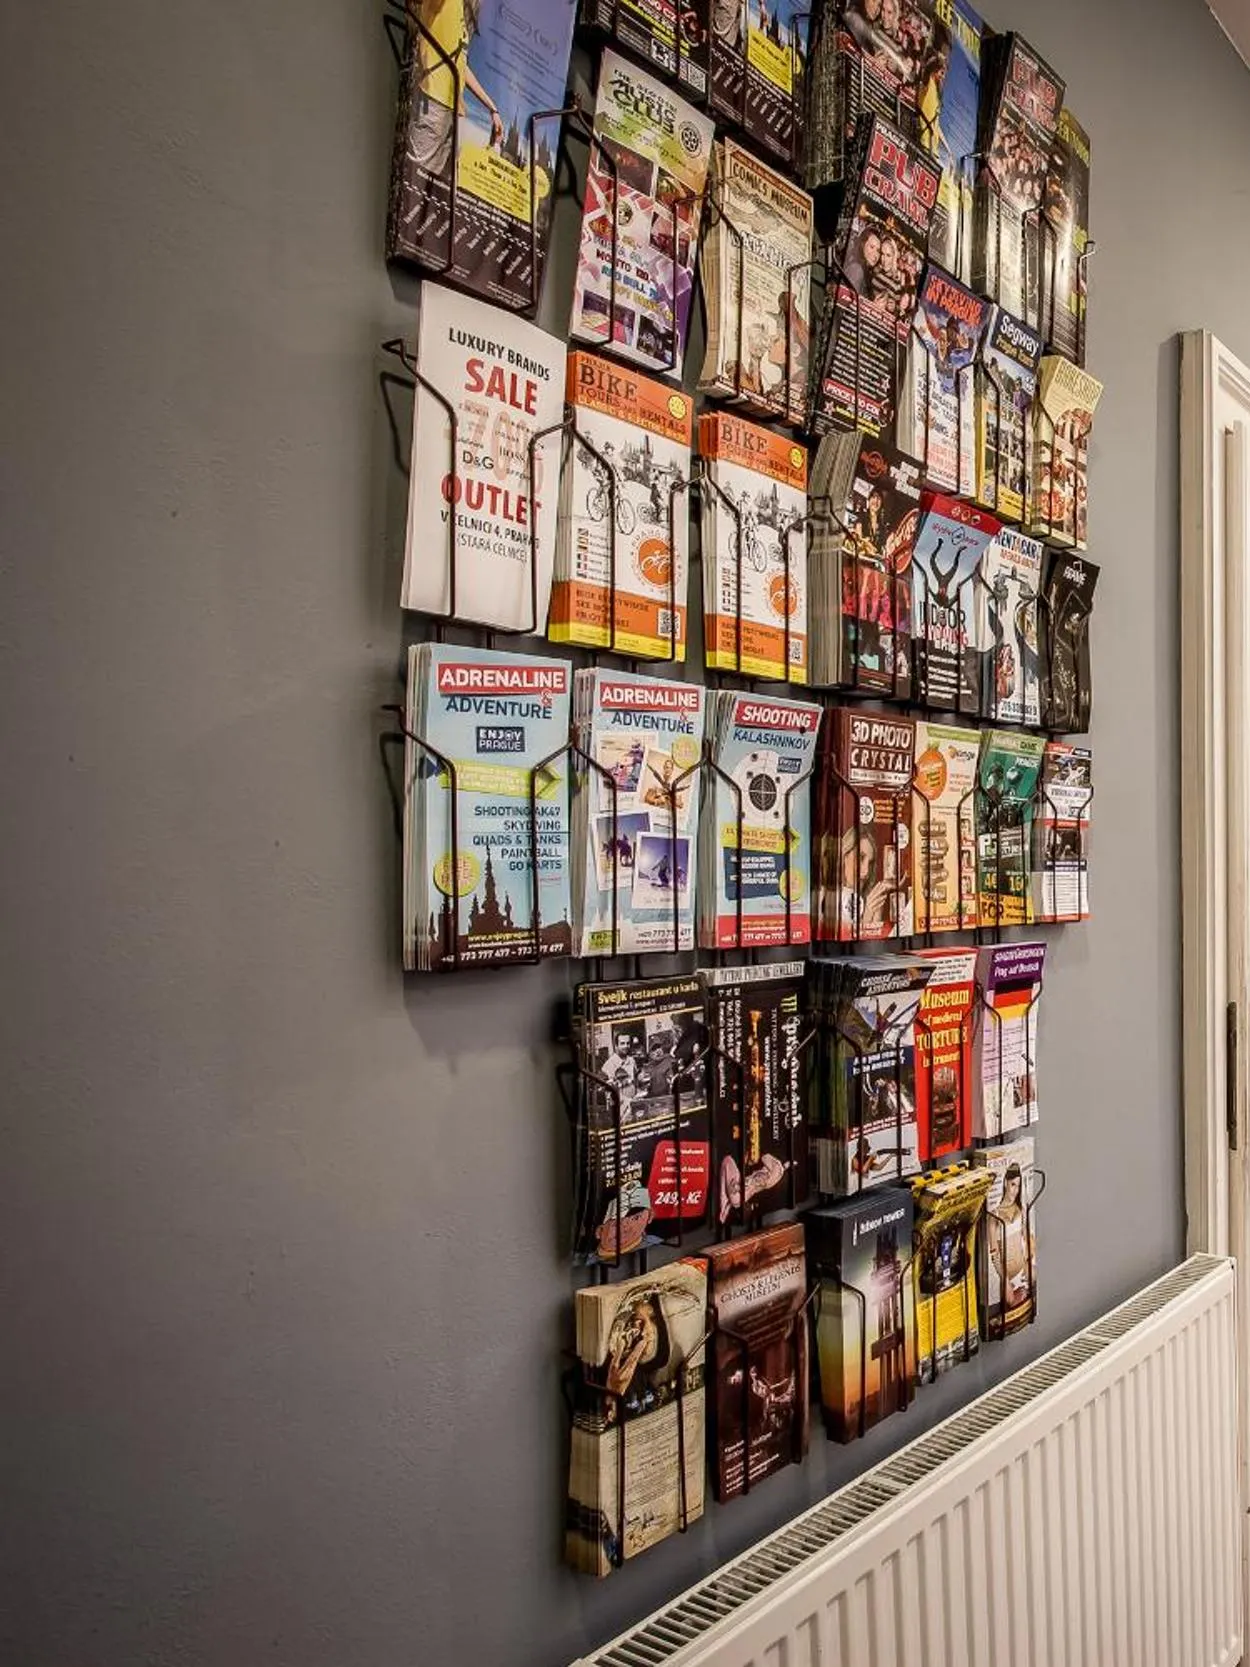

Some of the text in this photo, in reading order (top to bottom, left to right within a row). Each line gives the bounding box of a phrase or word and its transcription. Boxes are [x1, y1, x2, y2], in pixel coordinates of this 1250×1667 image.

[609, 79, 677, 123] MUSIC
[613, 90, 674, 140] CLUB
[869, 131, 938, 209] PUB
[732, 161, 808, 224] COMICS MUSEUM
[864, 166, 929, 232] CRAWL
[1000, 315, 1039, 357] Segway
[448, 328, 550, 381] LUXURY BRANDS
[465, 357, 537, 416] SALE
[580, 364, 638, 402] BIKE
[579, 386, 620, 408] TOURS
[640, 407, 686, 434] RENTALS
[722, 424, 767, 455] BIKE
[462, 449, 495, 470] D&G
[442, 473, 542, 525] OUTLET
[453, 513, 492, 534] ELNICI
[440, 667, 565, 689] ADRENALINE
[602, 686, 697, 707] ADRENALINE
[446, 697, 553, 719] ADVENTURE
[742, 706, 811, 728] SHOOTING
[611, 712, 694, 734] ADVENTURE
[479, 728, 522, 741] ENJOY
[733, 728, 811, 750] KALASHNIKOV
[852, 721, 910, 749] 3D PHOTO
[479, 740, 522, 752] PRAGUE
[851, 748, 910, 771] CRYSTAL
[474, 806, 531, 817] SHOOTING
[504, 820, 561, 830] SKYDVING
[473, 835, 512, 847] QUADS
[510, 862, 524, 872] GO
[629, 986, 672, 1000] restaurant
[920, 988, 969, 1009] Museum
[916, 1027, 967, 1051] TORTUE
